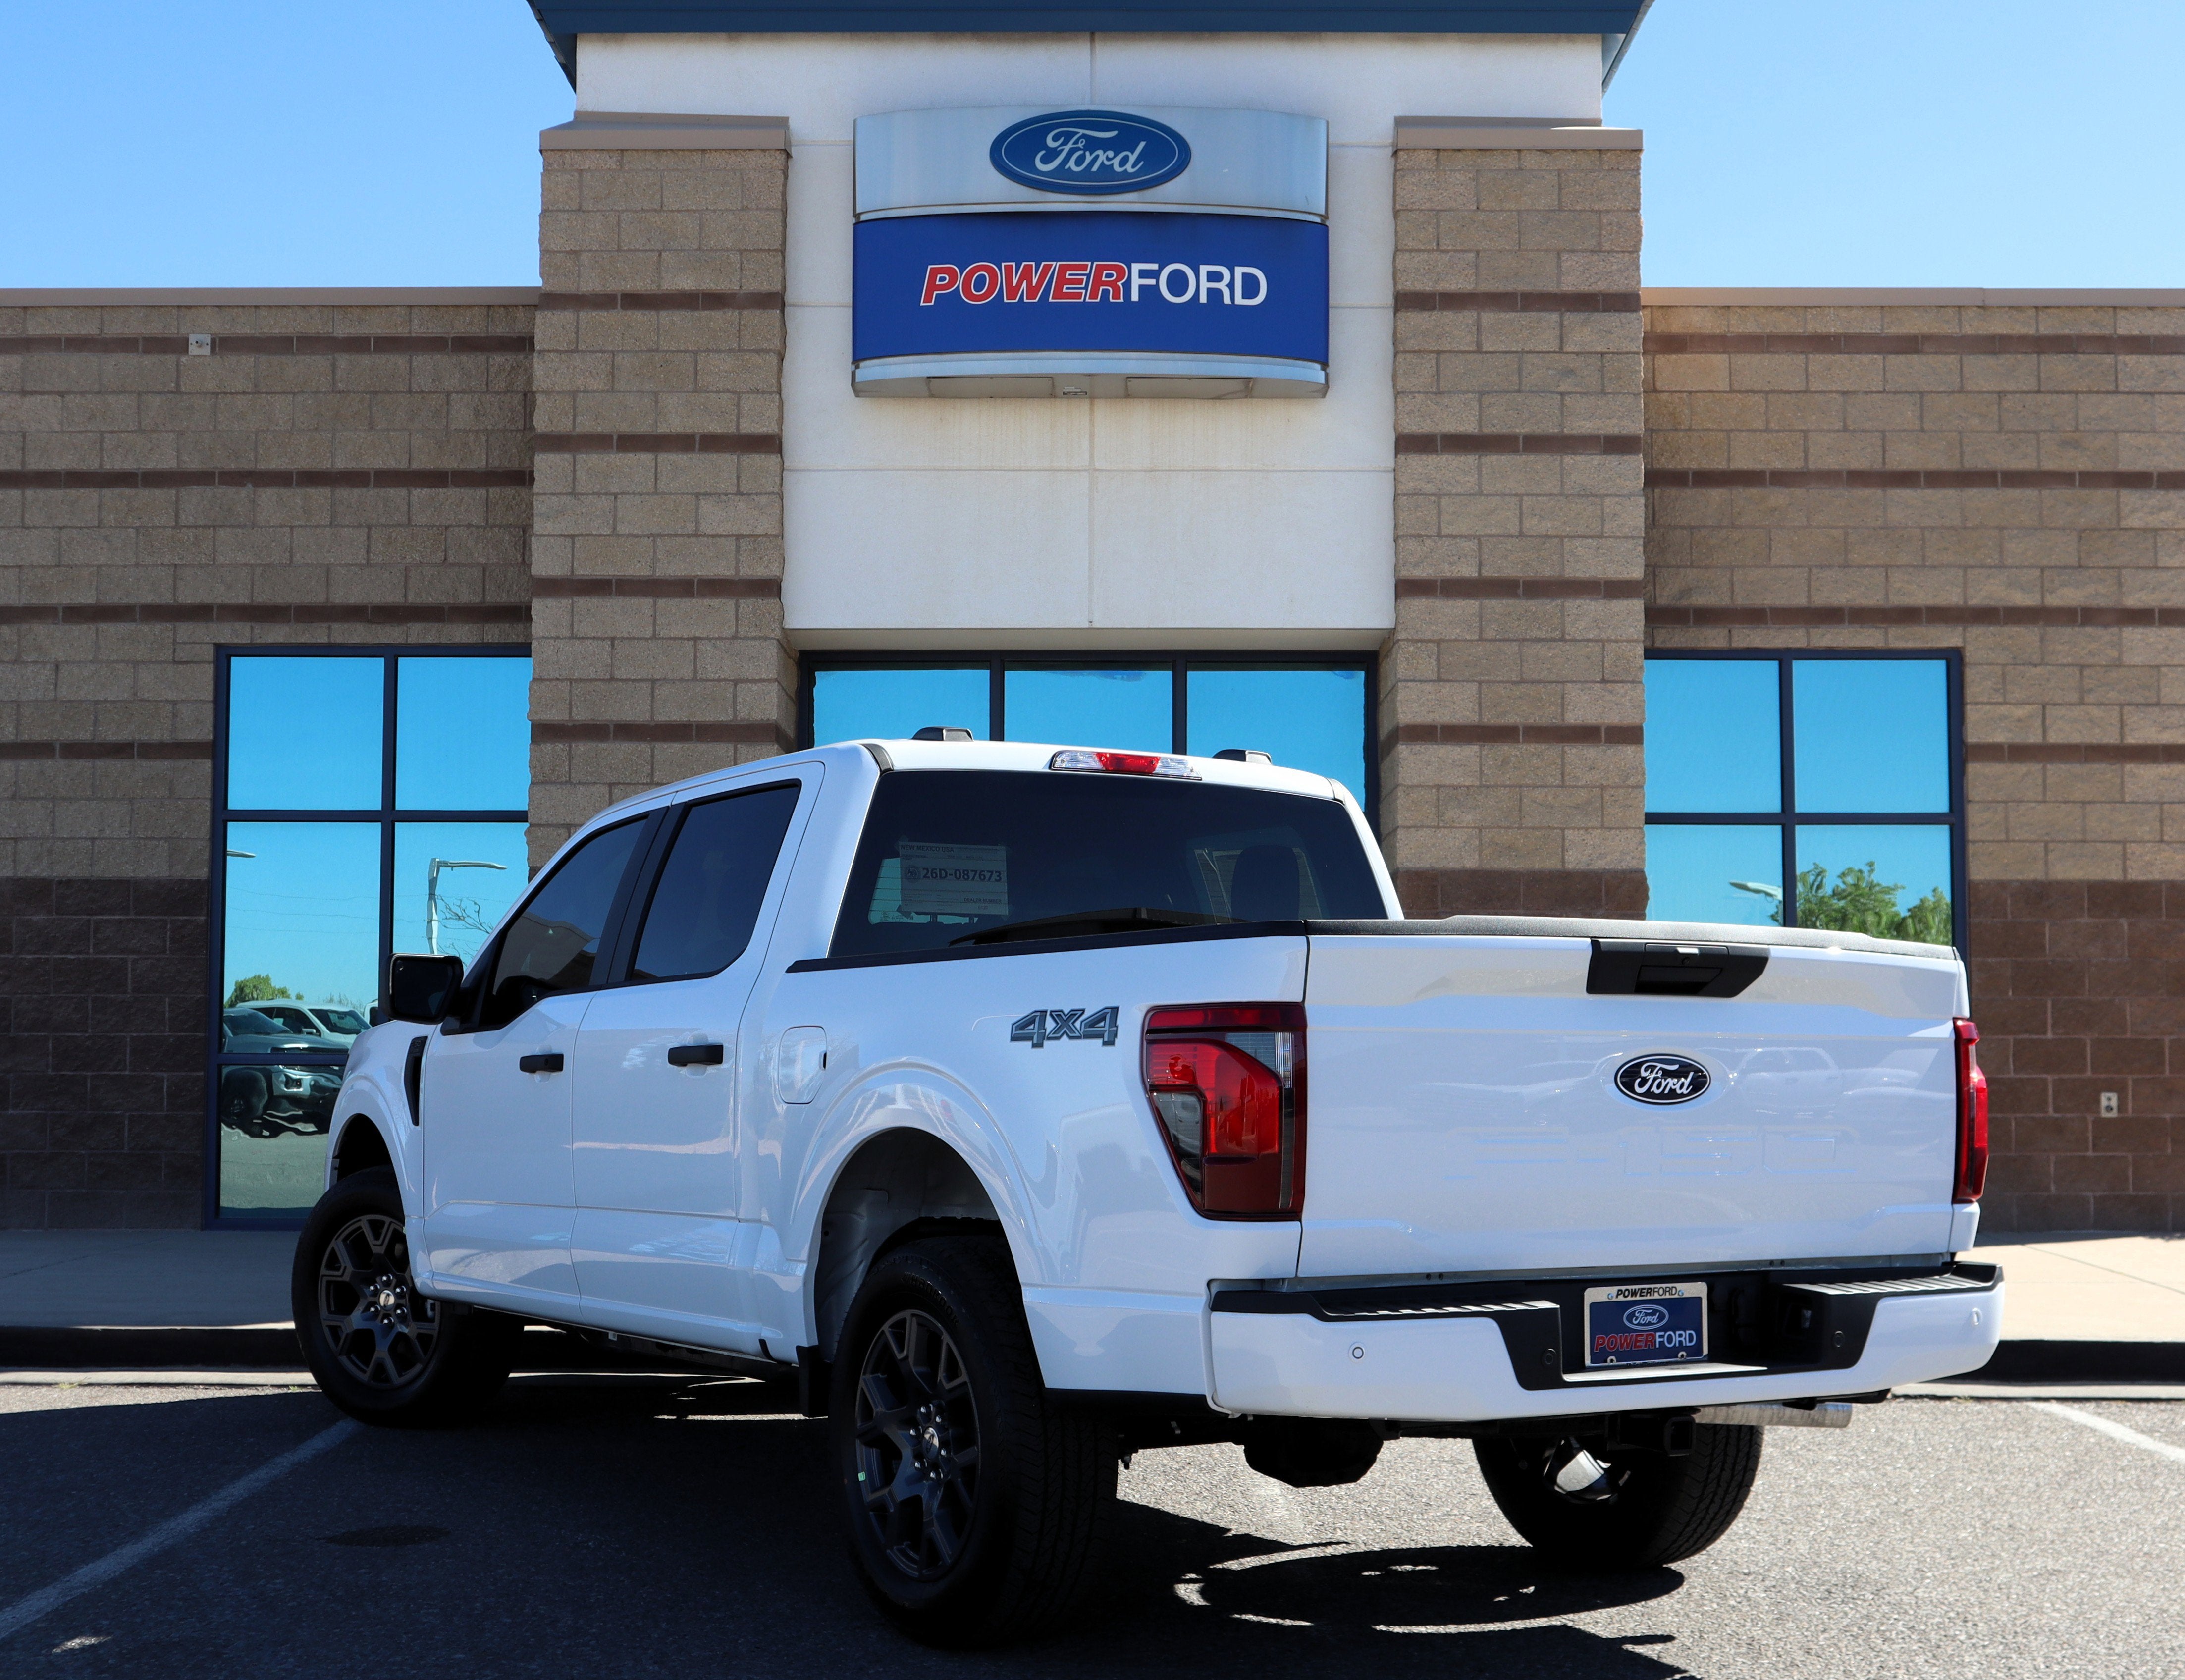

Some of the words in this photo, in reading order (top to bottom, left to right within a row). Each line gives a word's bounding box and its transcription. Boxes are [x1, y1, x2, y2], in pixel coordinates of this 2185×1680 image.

[1035, 127, 1146, 173] Ford
[923, 868, 1002, 882] 26D-087673
[1634, 1062, 1694, 1094] Ford
[1632, 1309, 1659, 1324] Ford
